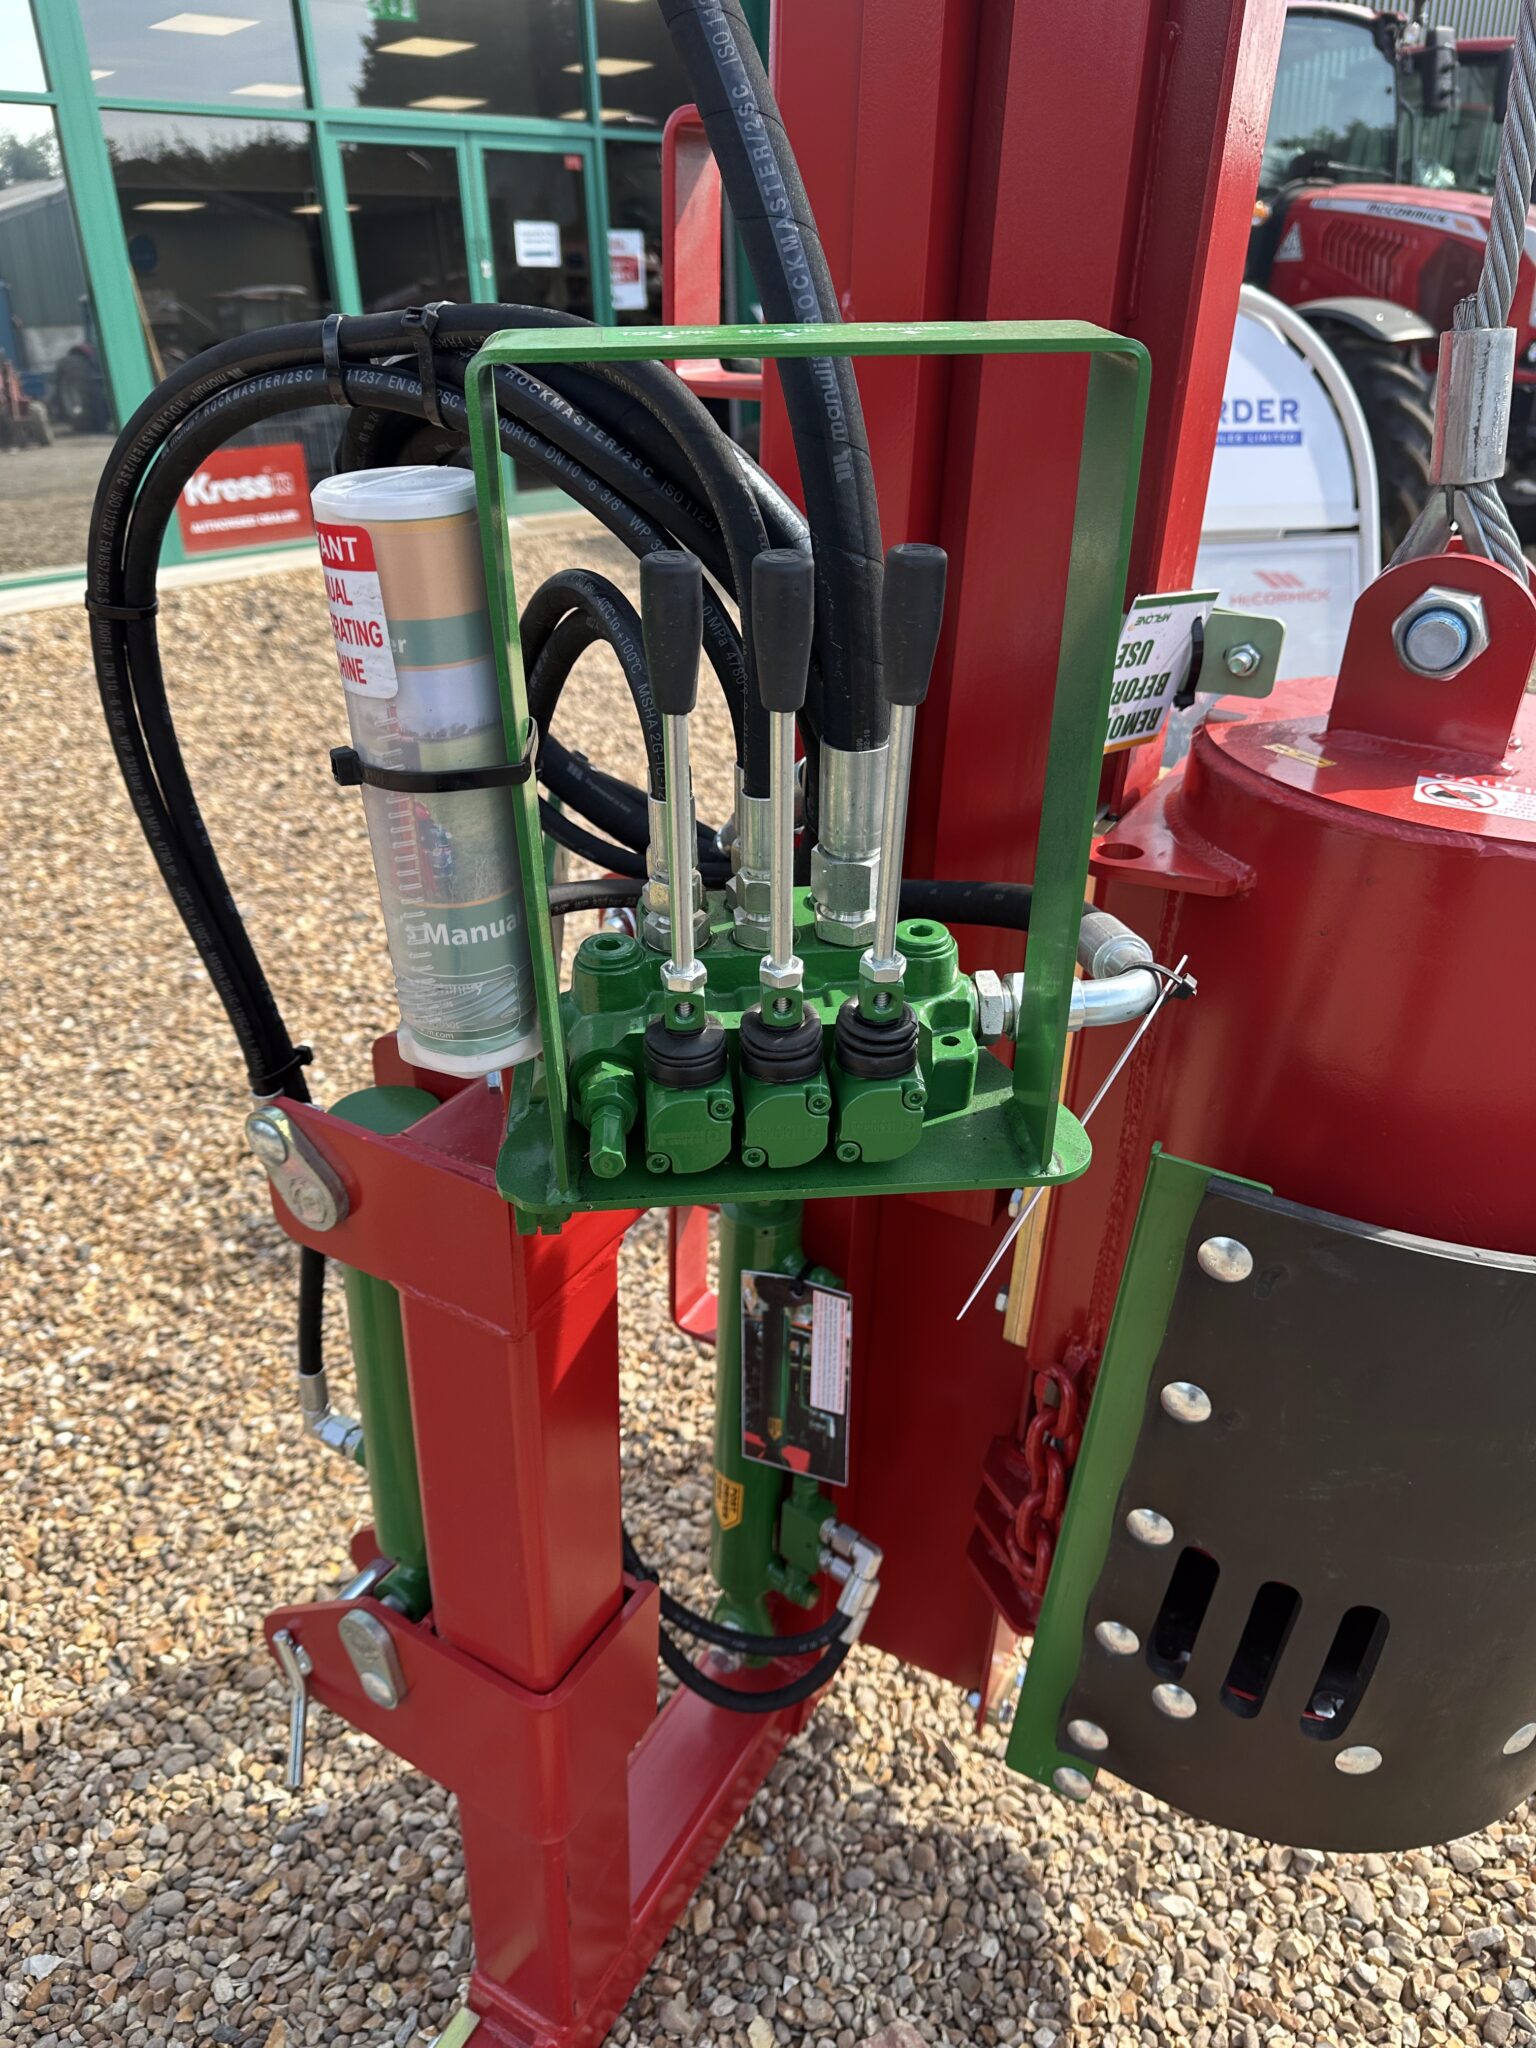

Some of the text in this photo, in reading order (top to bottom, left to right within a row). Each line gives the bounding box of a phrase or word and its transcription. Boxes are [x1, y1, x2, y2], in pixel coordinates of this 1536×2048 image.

[712, 31, 738, 66] ISO
[117, 399, 188, 487] ROCKMASTER/2SC
[204, 369, 313, 418] ROCKMASTER/2SC
[345, 366, 383, 387] 11237
[387, 374, 406, 391] EN
[544, 447, 566, 467] DN
[564, 459, 581, 479] 10
[629, 514, 652, 537] WP
[505, 369, 654, 478] ROCKMASTER/2SC
[659, 480, 684, 503] ISO
[106, 489, 124, 508] ISO
[183, 472, 273, 507] Kress
[100, 507, 118, 537] 11237
[98, 539, 113, 553] EN
[1115, 639, 1155, 669] USE
[610, 620, 621, 631] to
[637, 683, 658, 729] MSHA
